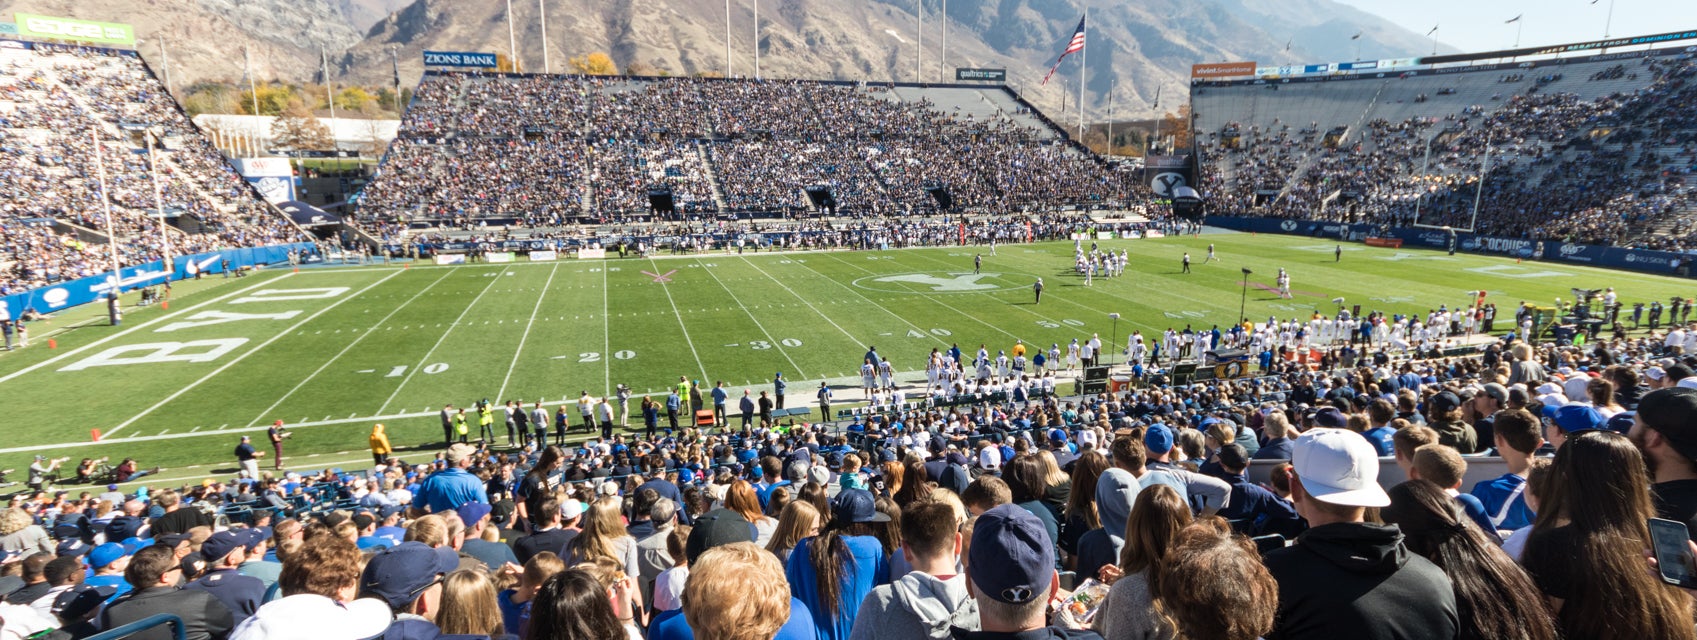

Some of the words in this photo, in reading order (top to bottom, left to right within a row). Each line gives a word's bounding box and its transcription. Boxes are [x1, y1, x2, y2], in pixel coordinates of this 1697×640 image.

[1567, 42, 1601, 51] REBATE
[1603, 39, 1629, 47] FROM
[1631, 34, 1681, 44] DOMINION
[424, 53, 461, 65] ZIONS
[463, 55, 495, 66] BANK
[960, 70, 984, 79] qualtrics
[1157, 175, 1183, 193] Y
[55, 286, 351, 372] BYU
[749, 337, 803, 350] 30
[576, 350, 637, 364] 20
[384, 362, 449, 378] 10
[1010, 589, 1023, 602] Y
